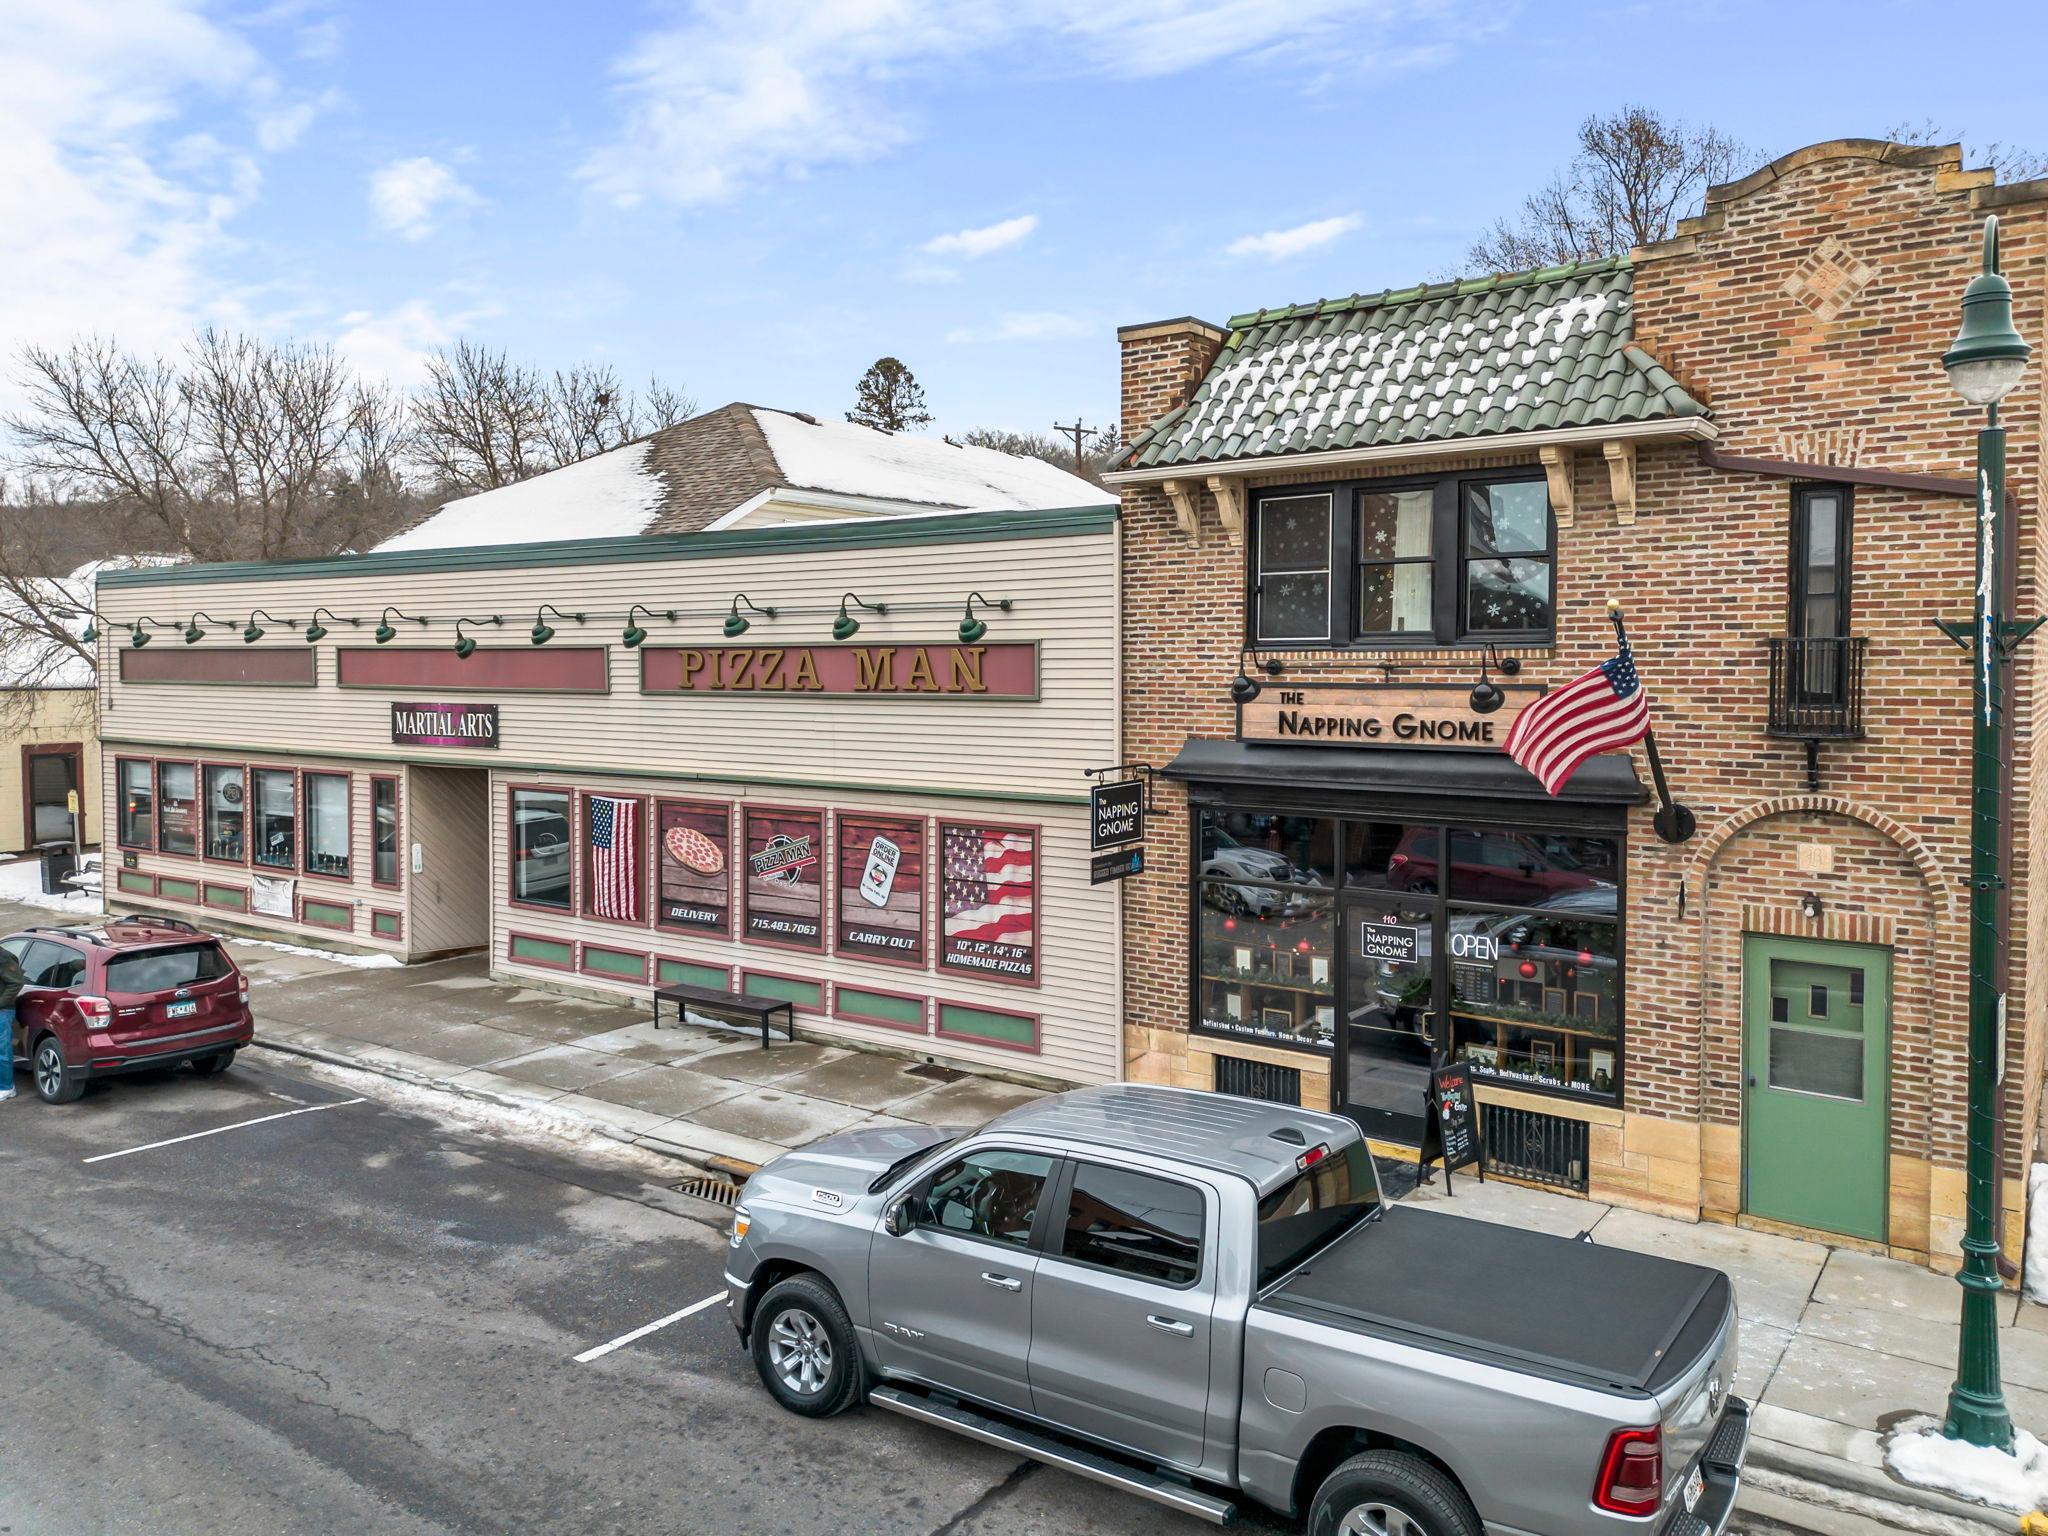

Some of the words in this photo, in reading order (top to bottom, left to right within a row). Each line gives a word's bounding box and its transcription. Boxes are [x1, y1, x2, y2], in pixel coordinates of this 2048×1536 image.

[678, 649, 824, 690] PIZZA
[852, 648, 988, 691] MAN
[1280, 692, 1305, 705] THE
[395, 711, 456, 736] MARTIAL
[457, 713, 493, 738] ARTS
[1098, 802, 1138, 820] NAPPING
[1098, 818, 1134, 836] GNOME
[754, 851, 785, 872] PIZZA
[784, 842, 811, 862] MAN
[873, 848, 895, 865] ONLINE
[875, 841, 897, 858] ORDER
[671, 907, 719, 922] DELIVERY
[1382, 915, 1397, 925] 110
[752, 918, 816, 935] 715.483.7063
[849, 931, 889, 946] CARRY
[890, 937, 915, 949] OUT
[1366, 933, 1413, 948] NAPPING
[1452, 933, 1499, 960] OPEN
[1367, 944, 1408, 957] GNOME
[946, 953, 997, 969] HOMEMADE
[998, 960, 1032, 974] PIZZAS
[1202, 1019, 1230, 1030] Refinished
[1235, 1025, 1253, 1034] Custom
[1278, 1031, 1293, 1040] Home
[1296, 1034, 1312, 1043] Decor
[1538, 1075, 1561, 1086] Scrubs
[1571, 1081, 1590, 1091] MORE
